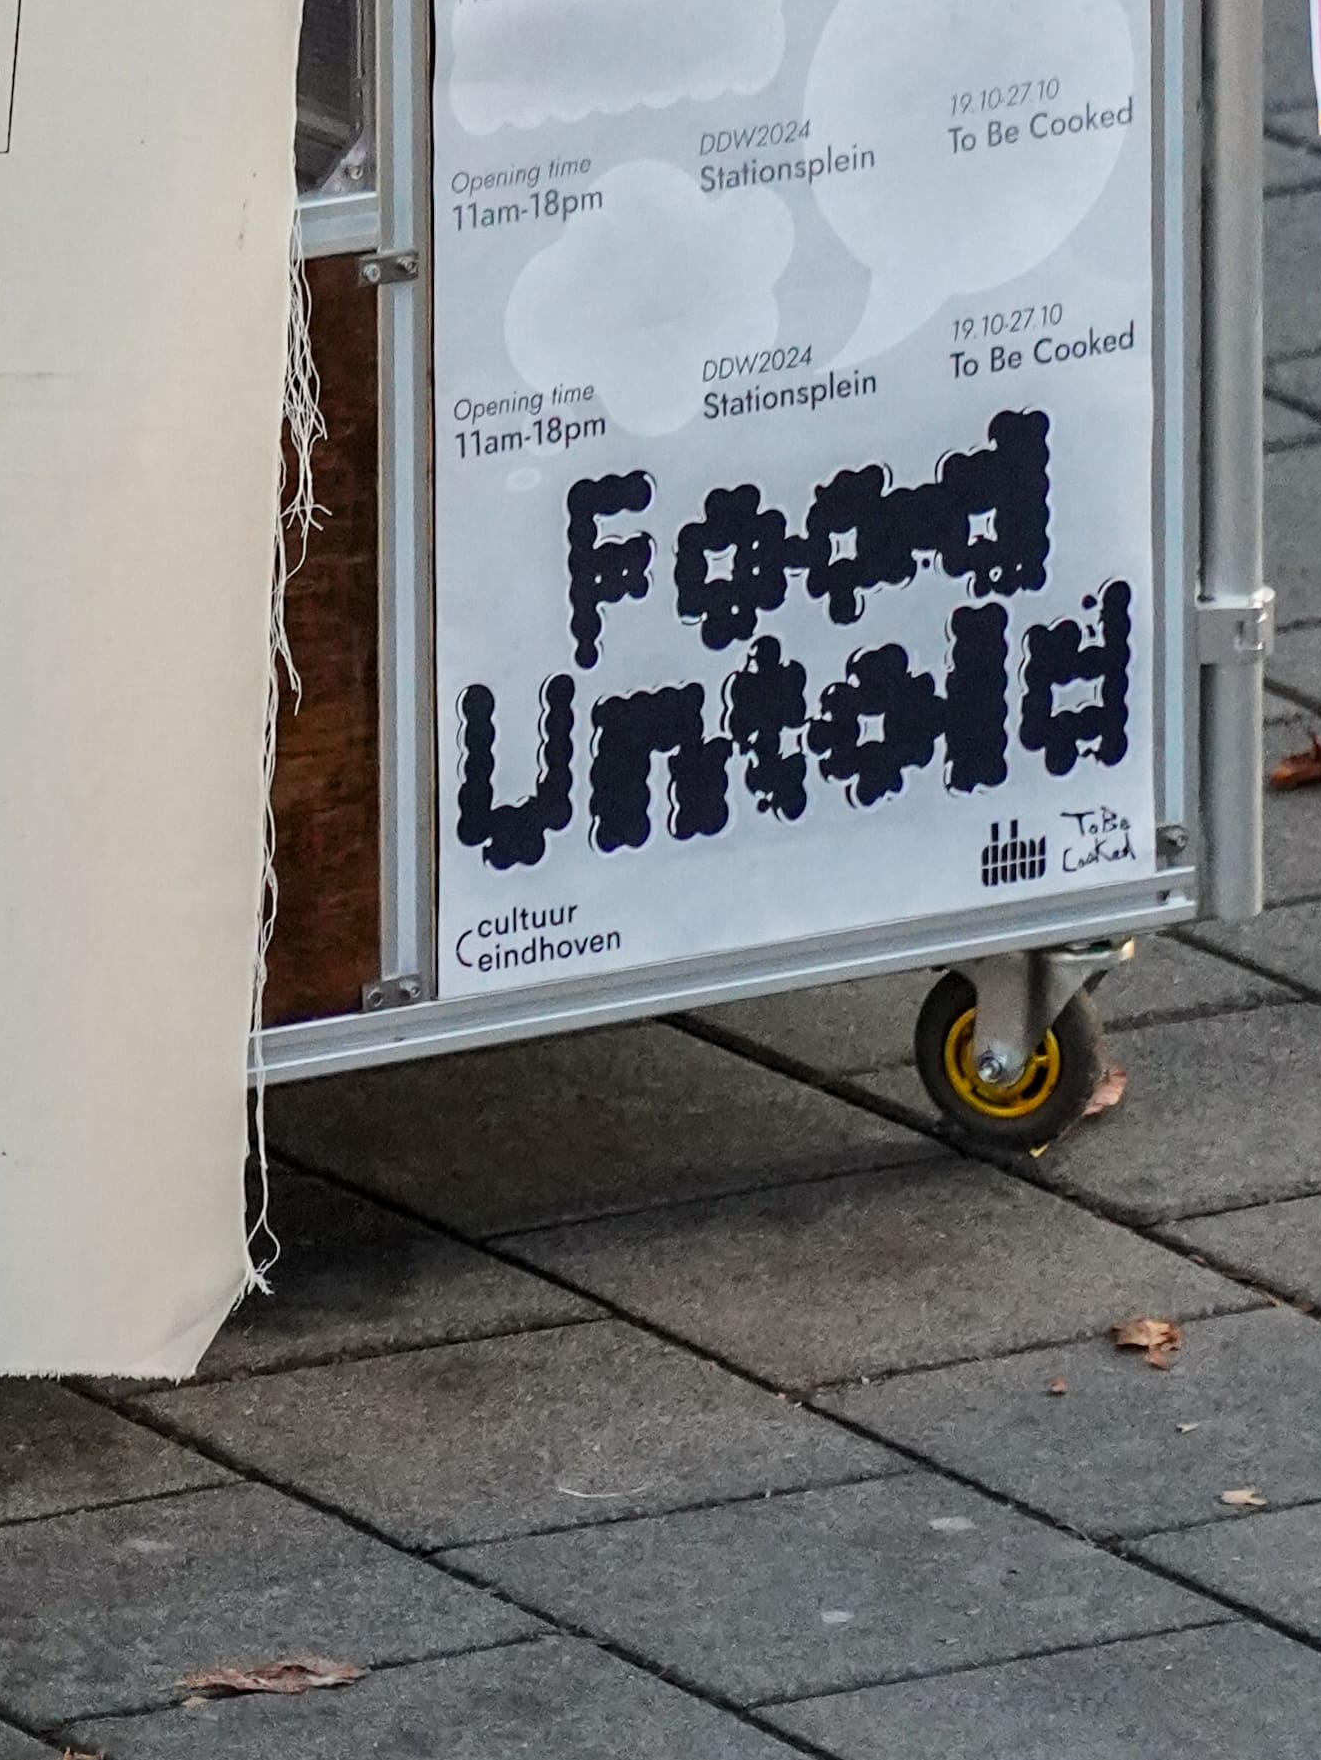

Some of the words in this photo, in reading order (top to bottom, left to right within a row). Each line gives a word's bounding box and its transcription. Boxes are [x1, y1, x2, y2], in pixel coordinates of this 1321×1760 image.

[699, 120, 811, 157] DDW2024
[949, 125, 976, 156] To
[987, 120, 1020, 149] Be
[1030, 96, 1133, 141] Cooked
[451, 160, 540, 195] Opening
[549, 155, 590, 178] time
[700, 145, 875, 195] Stationsplein
[452, 186, 604, 233] 11am-18pm
[702, 345, 814, 382] DDW2024
[950, 350, 978, 380] To
[990, 345, 1024, 373] Be
[1033, 323, 1135, 366] Cooked
[454, 387, 544, 423] Opening
[552, 381, 595, 406] time
[703, 372, 878, 422] Stationsplein
[455, 413, 607, 459] 11am-18pm
[567, 408, 1051, 670] Food
[456, 580, 1133, 870] Untold
[477, 901, 578, 940] cultuur
[477, 928, 621, 974] eindhoven
